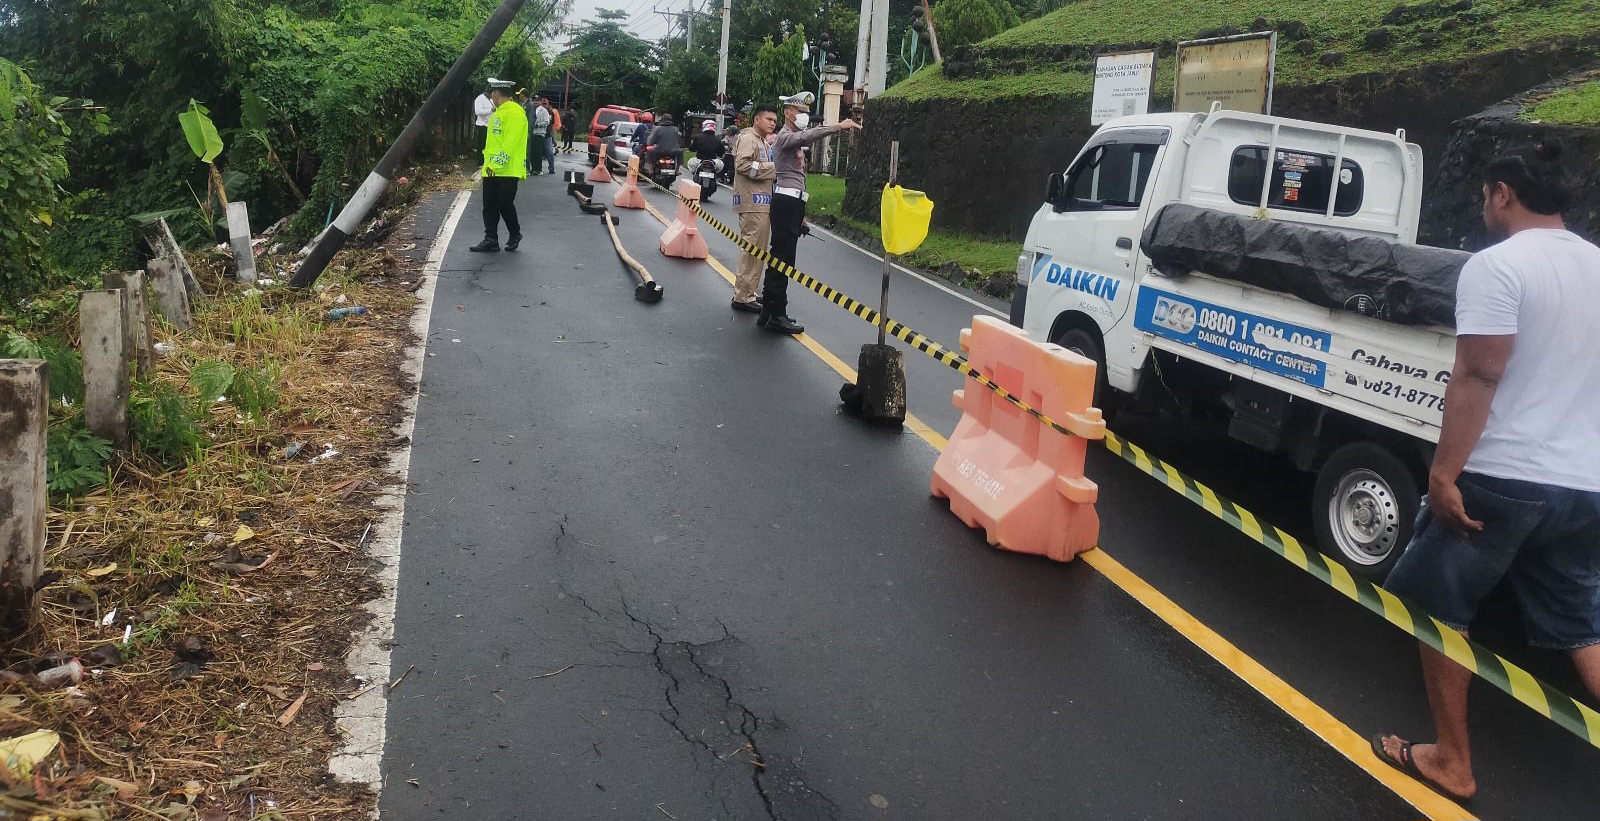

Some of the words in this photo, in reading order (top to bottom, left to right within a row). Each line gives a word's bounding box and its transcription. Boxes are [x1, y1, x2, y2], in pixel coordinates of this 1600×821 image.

[1046, 262, 1121, 302] DAIKIN
[1199, 307, 1236, 334] 0800
[1241, 319, 1249, 340] 1
[1197, 330, 1227, 349] DAIKIN
[1228, 340, 1274, 362] CONTACT
[1275, 353, 1319, 376] CENTER
